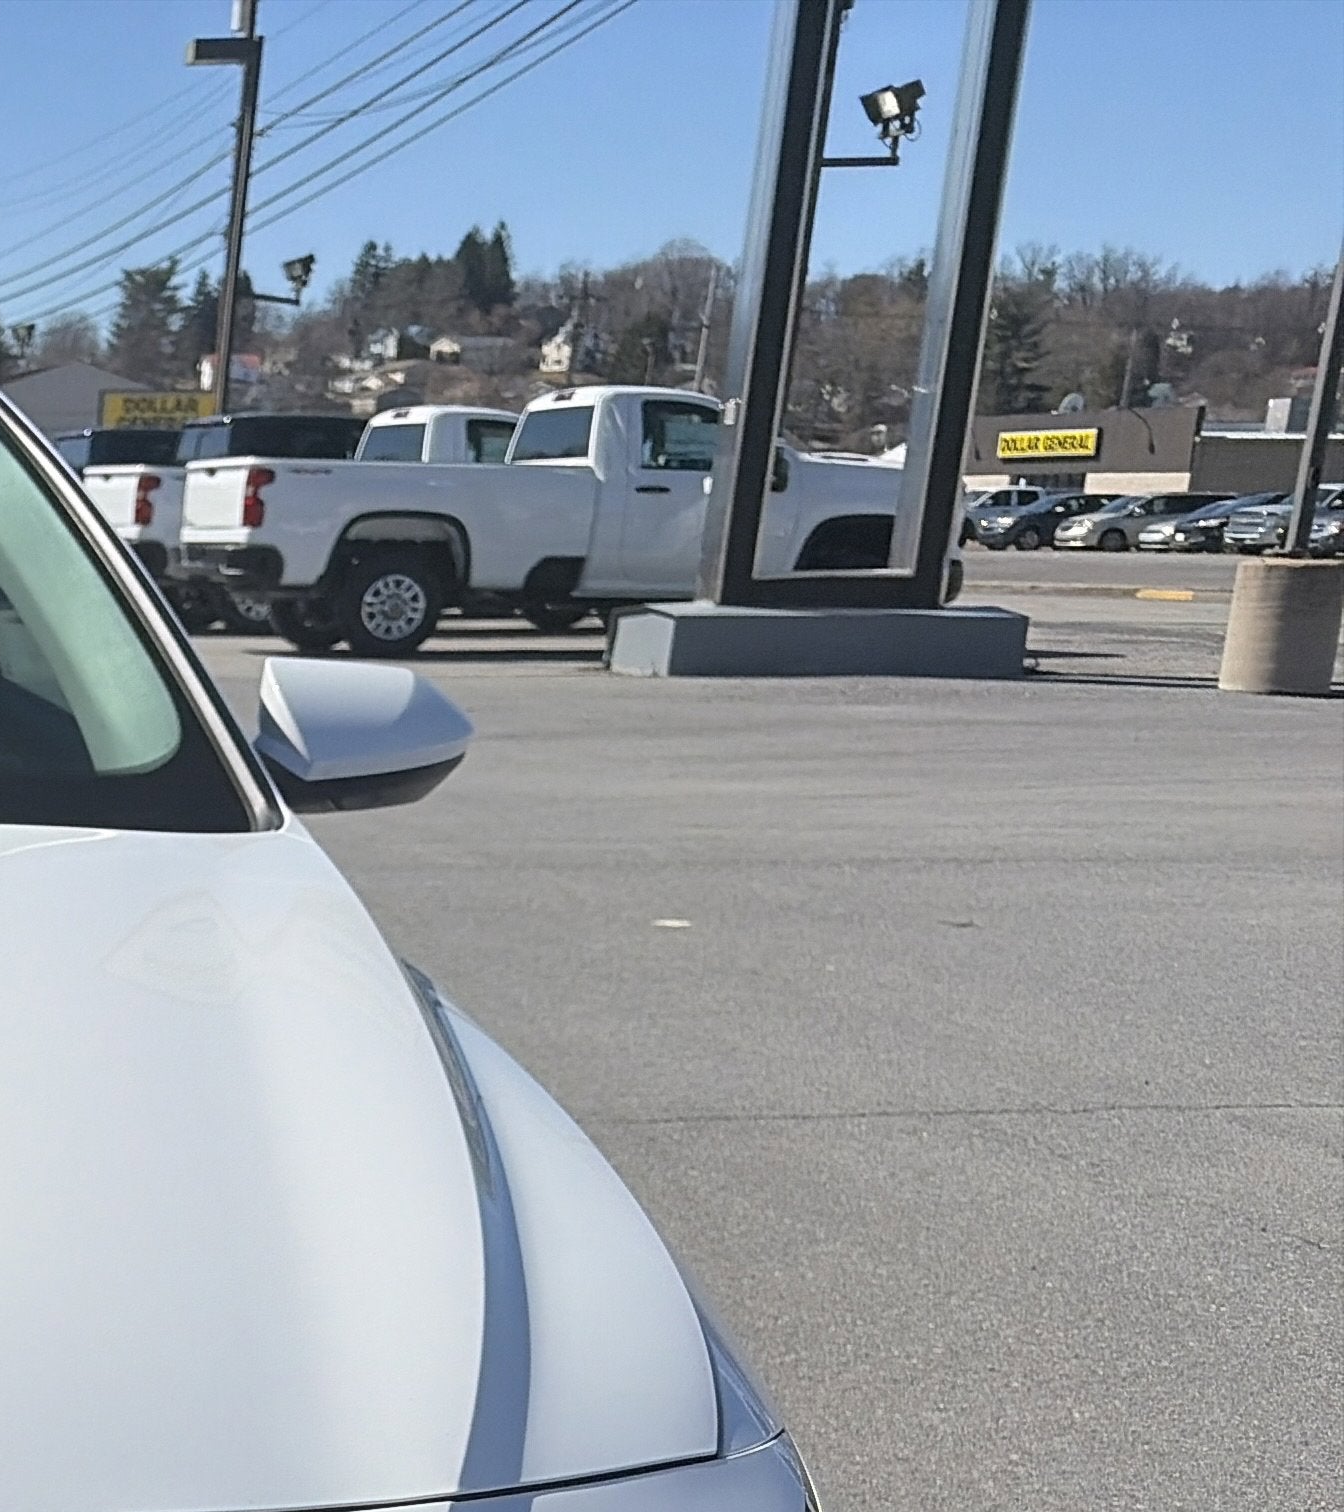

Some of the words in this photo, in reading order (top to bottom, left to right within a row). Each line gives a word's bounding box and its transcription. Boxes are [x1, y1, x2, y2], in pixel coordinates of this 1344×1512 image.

[123, 397, 199, 414] DOLLAR
[1001, 436, 1040, 453] DOLLAR
[1042, 433, 1092, 452] GENERAL
